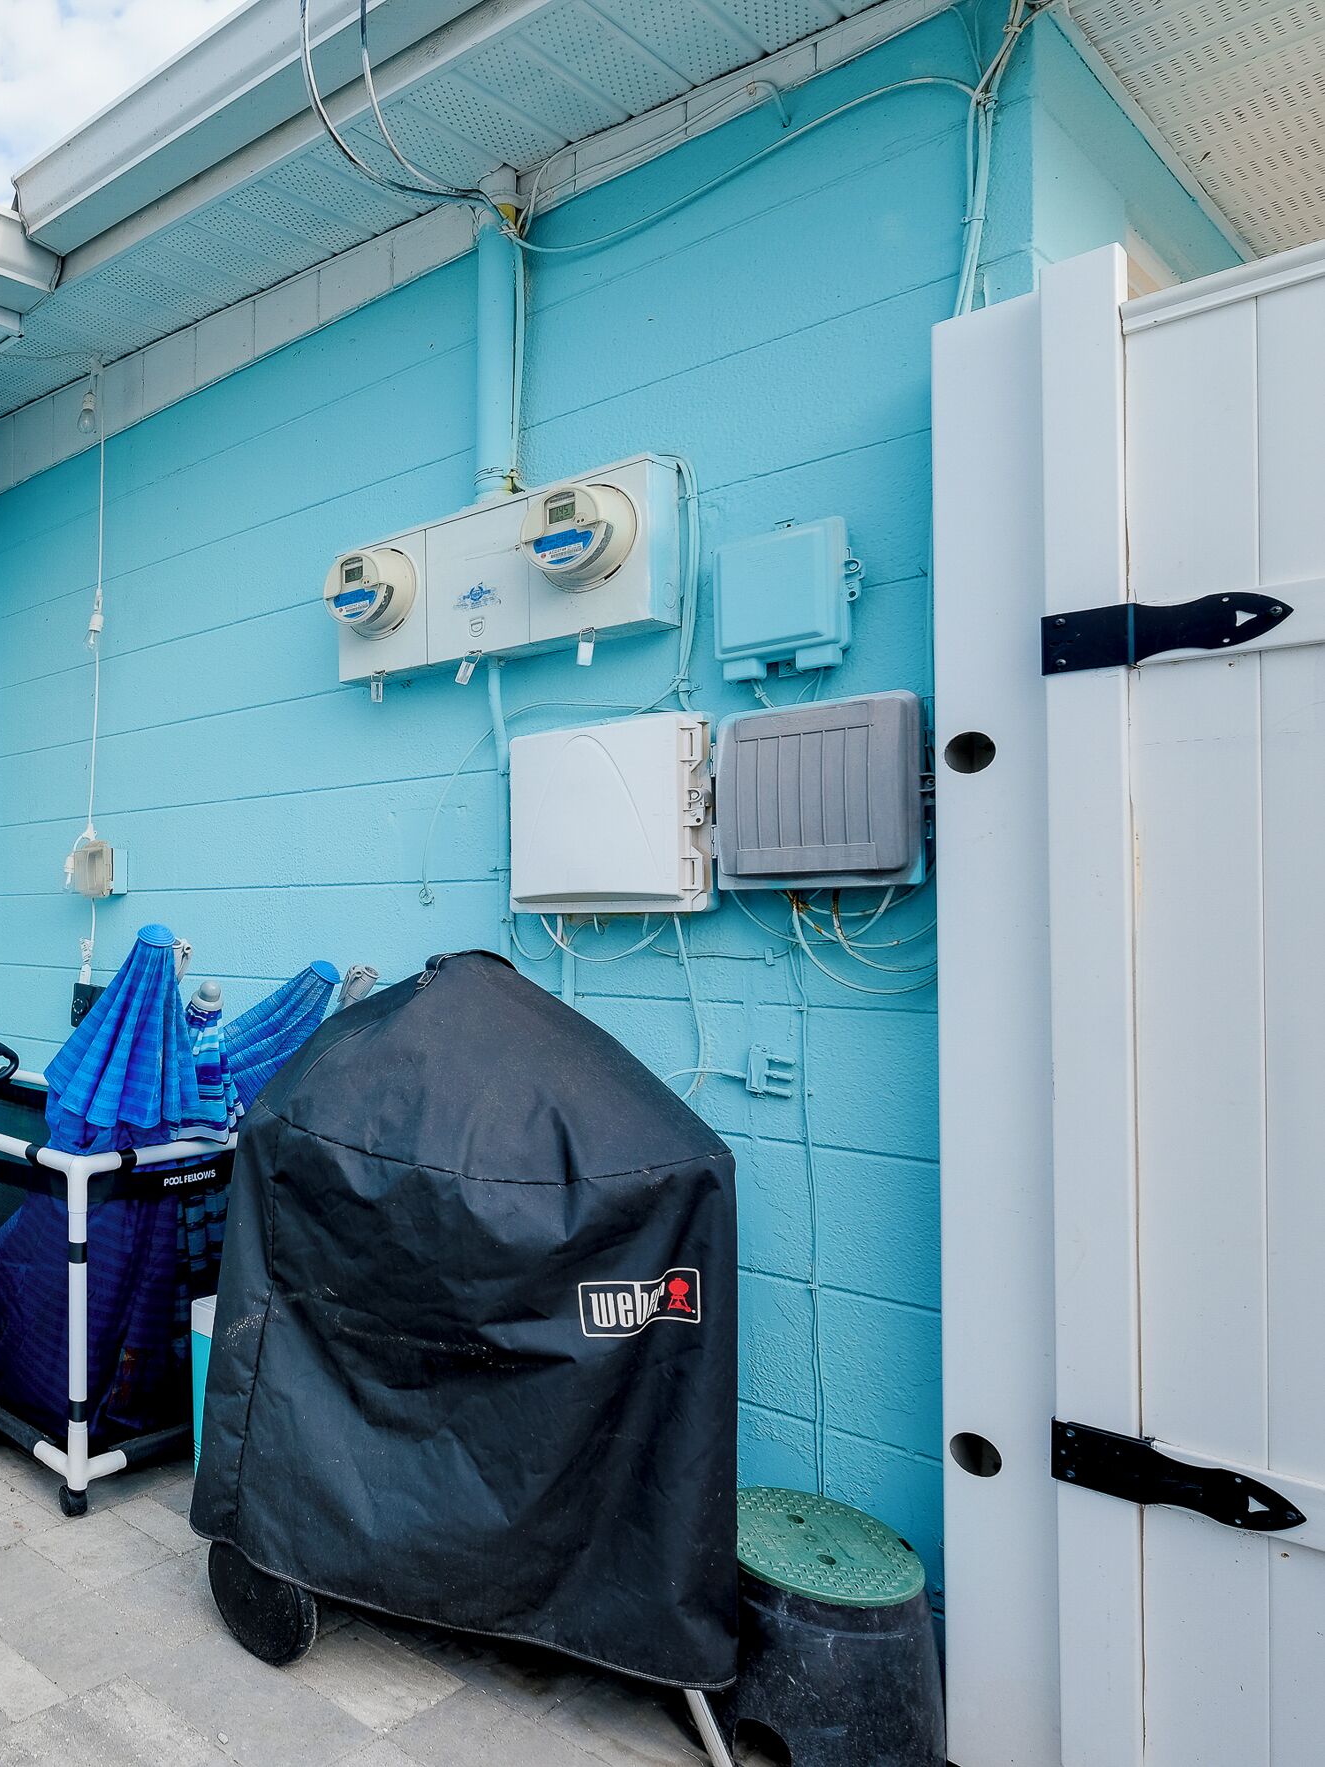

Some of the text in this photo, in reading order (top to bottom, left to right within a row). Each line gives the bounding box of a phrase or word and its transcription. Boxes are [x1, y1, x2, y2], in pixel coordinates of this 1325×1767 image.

[163, 1169, 216, 1187] POOL FELLOWS
[589, 1281, 665, 1328] weber
